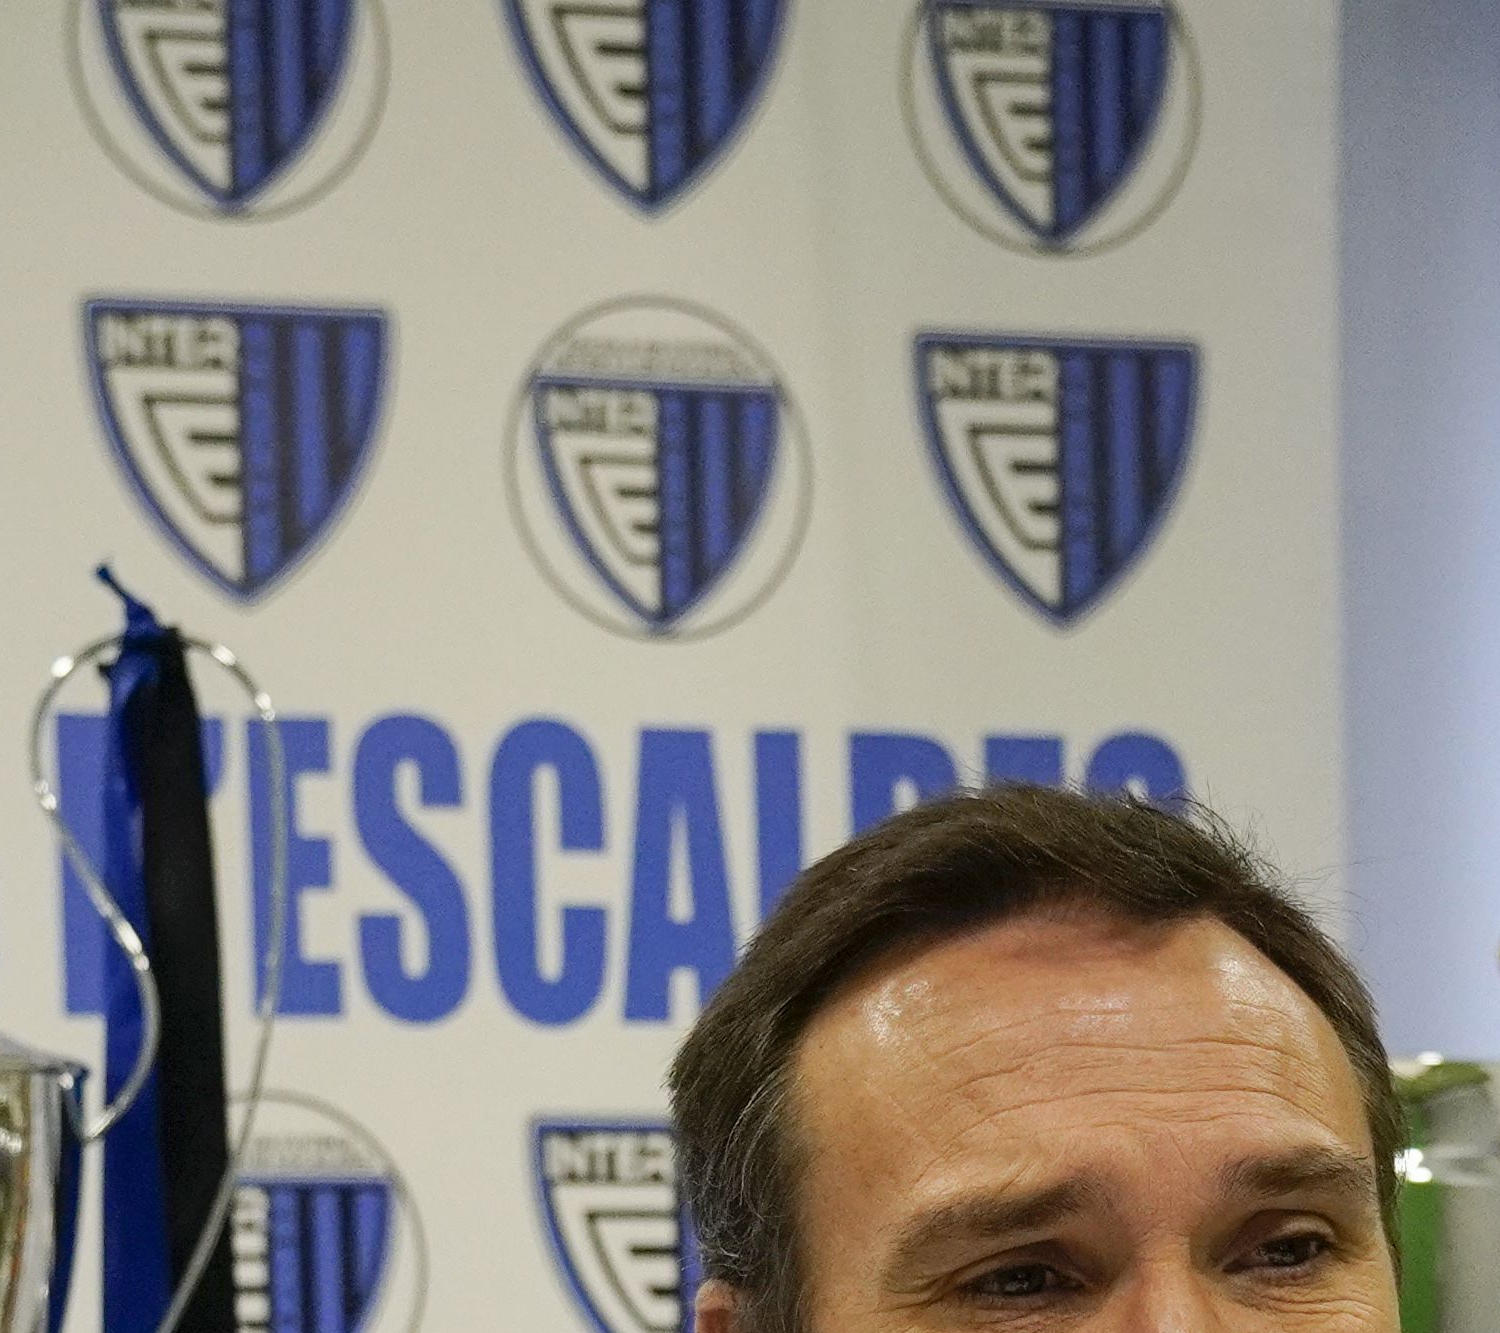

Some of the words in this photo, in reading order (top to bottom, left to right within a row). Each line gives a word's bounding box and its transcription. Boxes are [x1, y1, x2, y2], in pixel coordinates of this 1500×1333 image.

[944, 7, 1051, 55] INTER
[99, 315, 239, 368] INTER
[930, 351, 1060, 400] INTER
[546, 387, 659, 434] INTER
[544, 1131, 677, 1183] INTER
